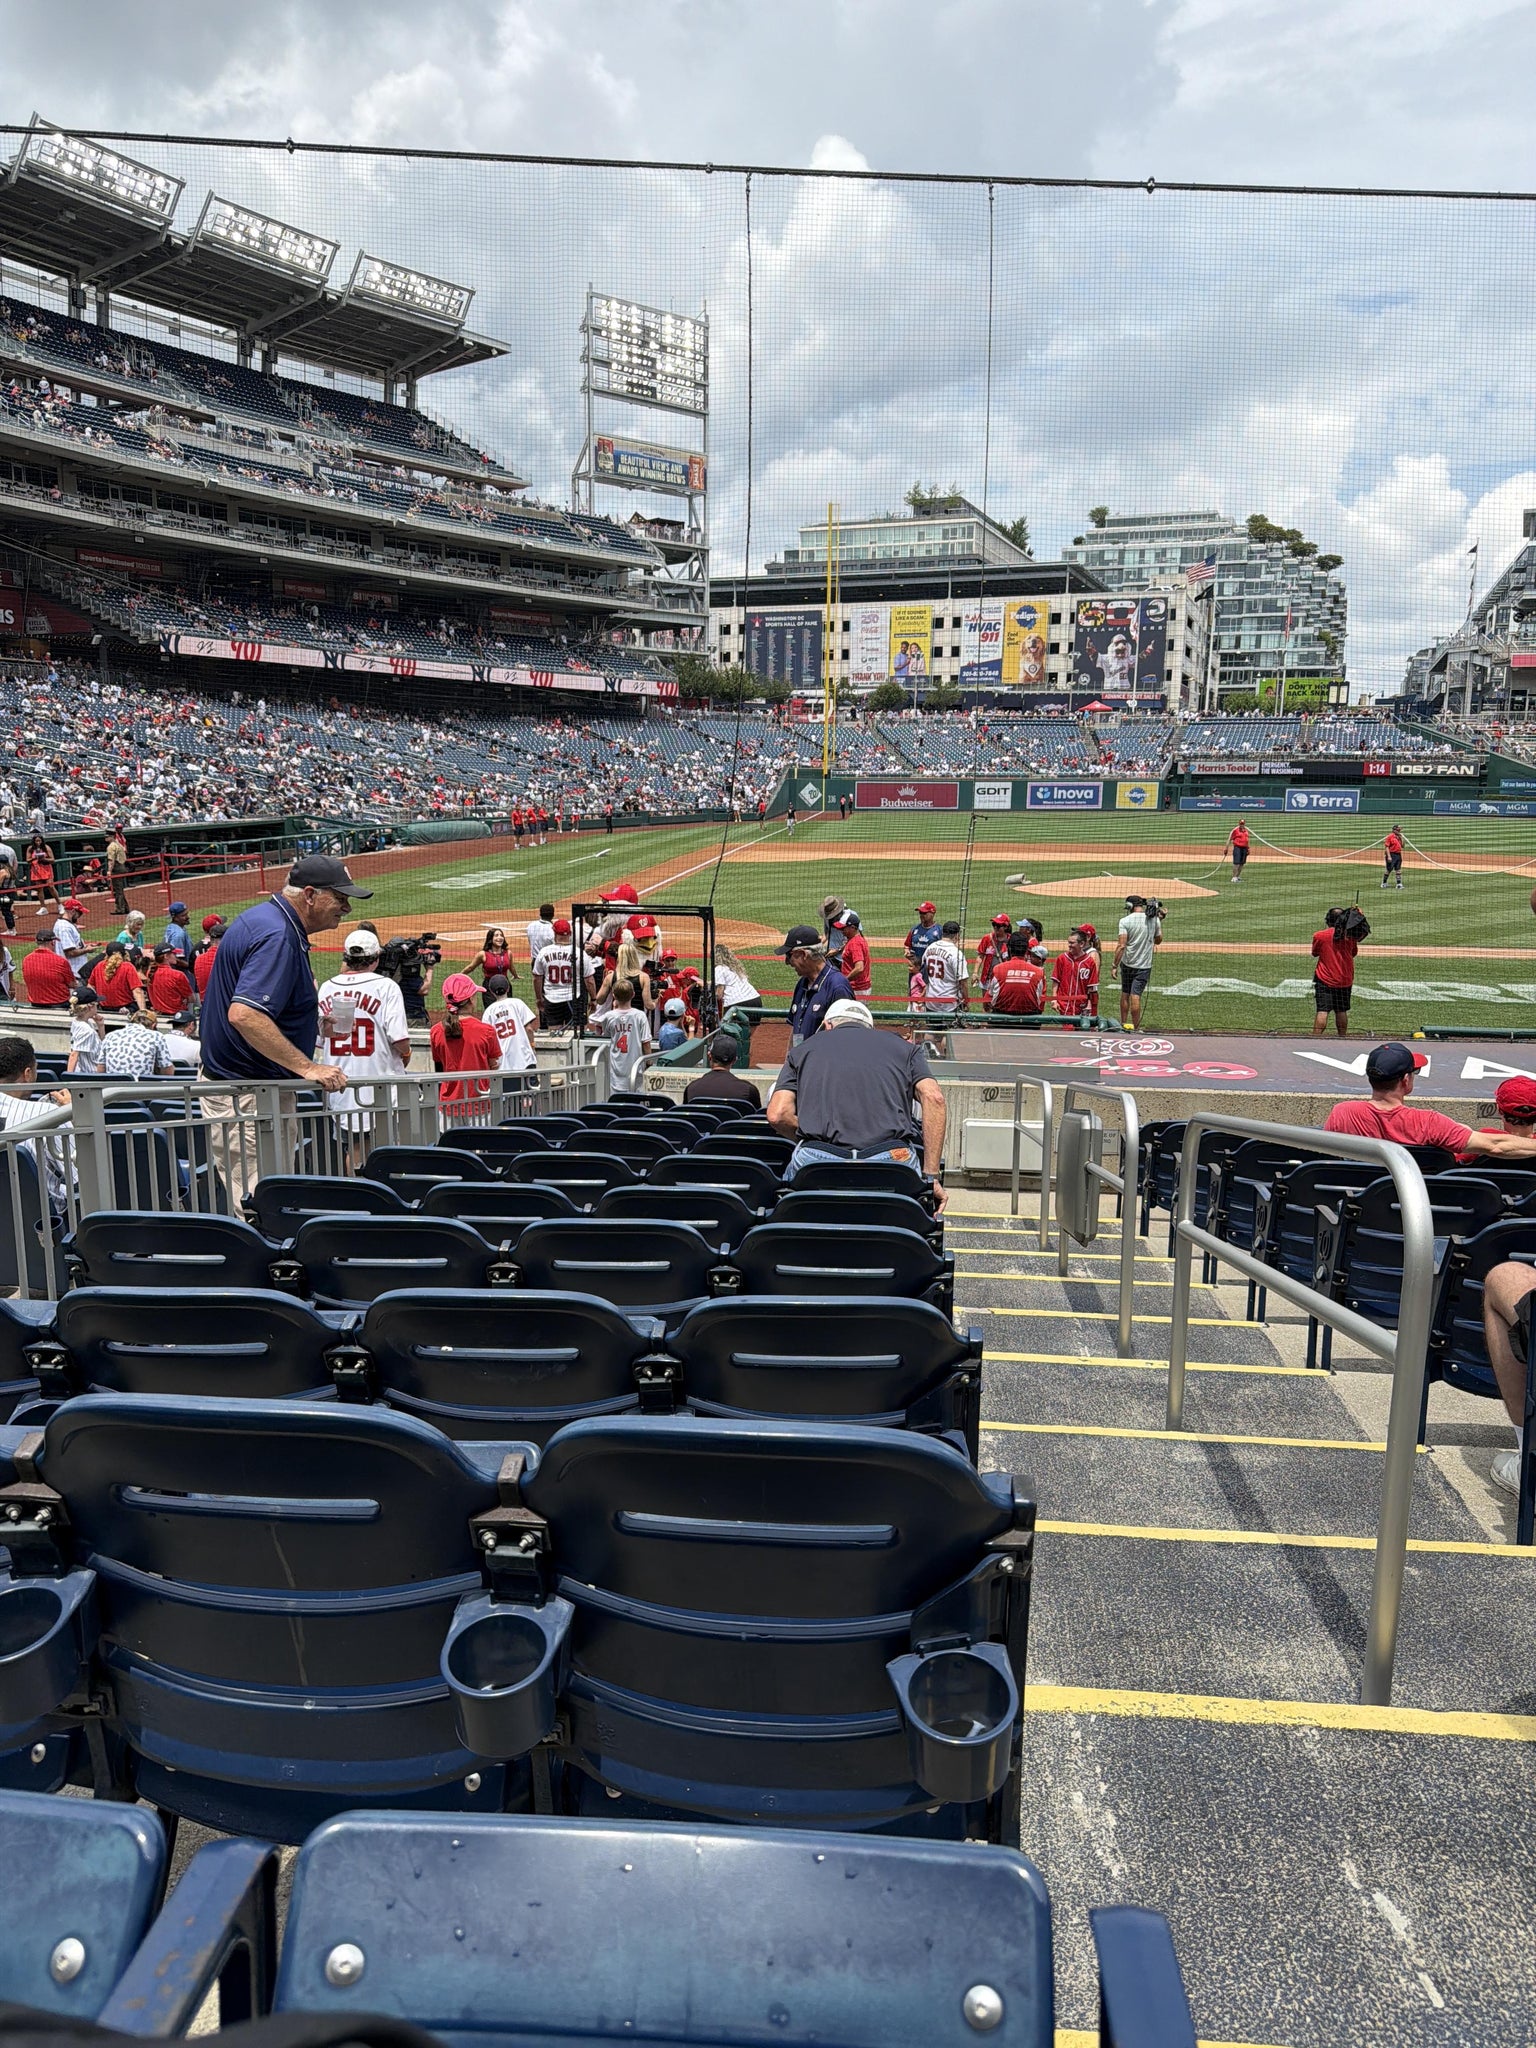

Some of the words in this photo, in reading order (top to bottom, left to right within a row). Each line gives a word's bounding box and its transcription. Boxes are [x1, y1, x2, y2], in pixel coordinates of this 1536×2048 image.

[620, 454, 651, 469] BEAUTIFUL
[651, 460, 670, 471] VIEWS
[671, 463, 683, 473] AND
[618, 464, 639, 477] AWARD
[640, 468, 665, 481] WINNING
[666, 473, 686, 484] BREWS
[968, 622, 1002, 632] HVAC
[981, 632, 999, 642] 911
[1198, 764, 1226, 772] Harris
[1226, 764, 1257, 772] Teeter
[1368, 763, 1385, 774] 1:14
[1396, 765, 1434, 775] 106.7
[1436, 765, 1474, 775] FAN
[1053, 787, 1094, 799] Inova
[1424, 790, 1436, 799] 377
[1310, 794, 1353, 808] Terra
[1506, 803, 1528, 811] MGM
[544, 951, 578, 963] WINGMA
[549, 965, 573, 984] 00
[928, 958, 945, 979] 63
[1007, 969, 1036, 977] BEST
[495, 1019, 517, 1039] 29
[615, 1023, 632, 1032] LILE
[330, 1017, 375, 1056] 20
[617, 1034, 628, 1053] 4
